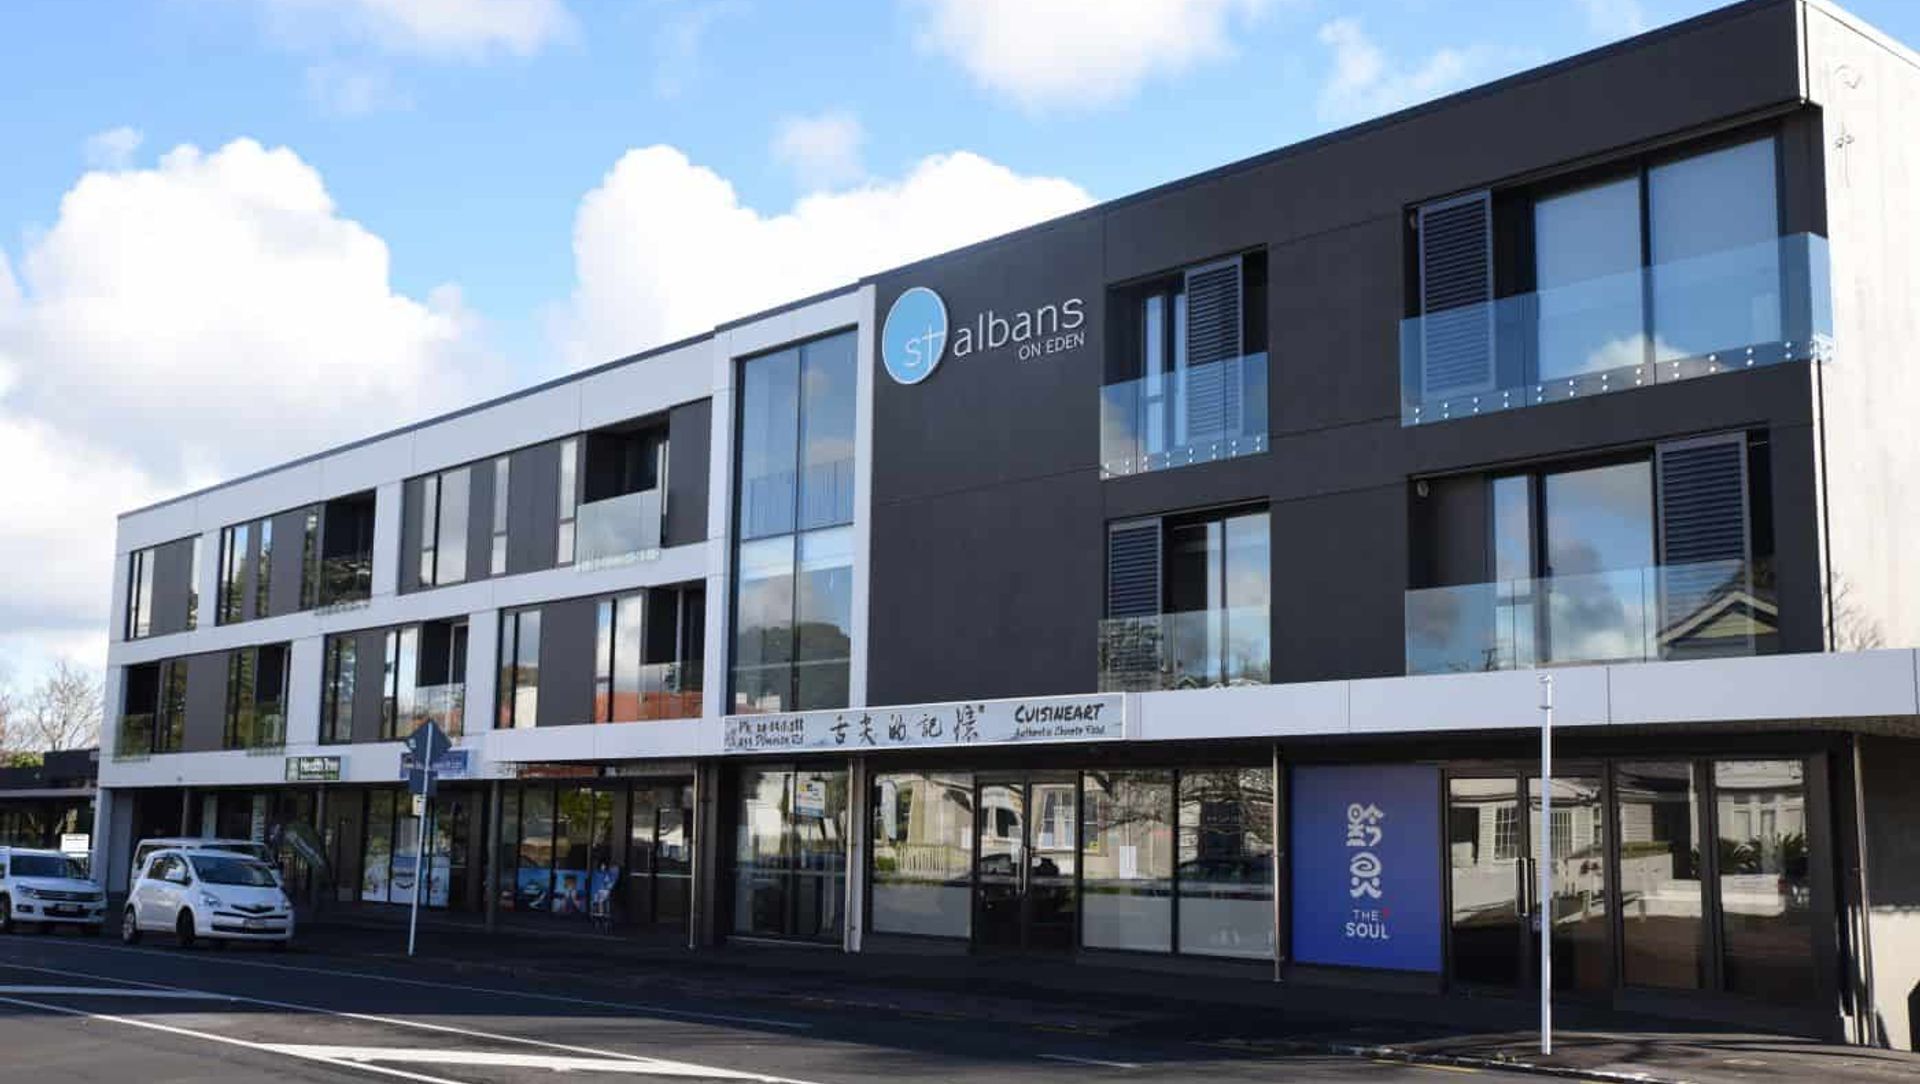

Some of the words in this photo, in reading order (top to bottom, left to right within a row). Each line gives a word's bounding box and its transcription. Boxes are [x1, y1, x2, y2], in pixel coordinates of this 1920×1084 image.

[954, 298, 1085, 357] albans
[1018, 342, 1042, 361] ON
[1046, 331, 1085, 353] EDEN
[1014, 703, 1105, 723] CUISINEART
[1352, 909, 1379, 922] THE
[1346, 922, 1390, 940] SOUL
